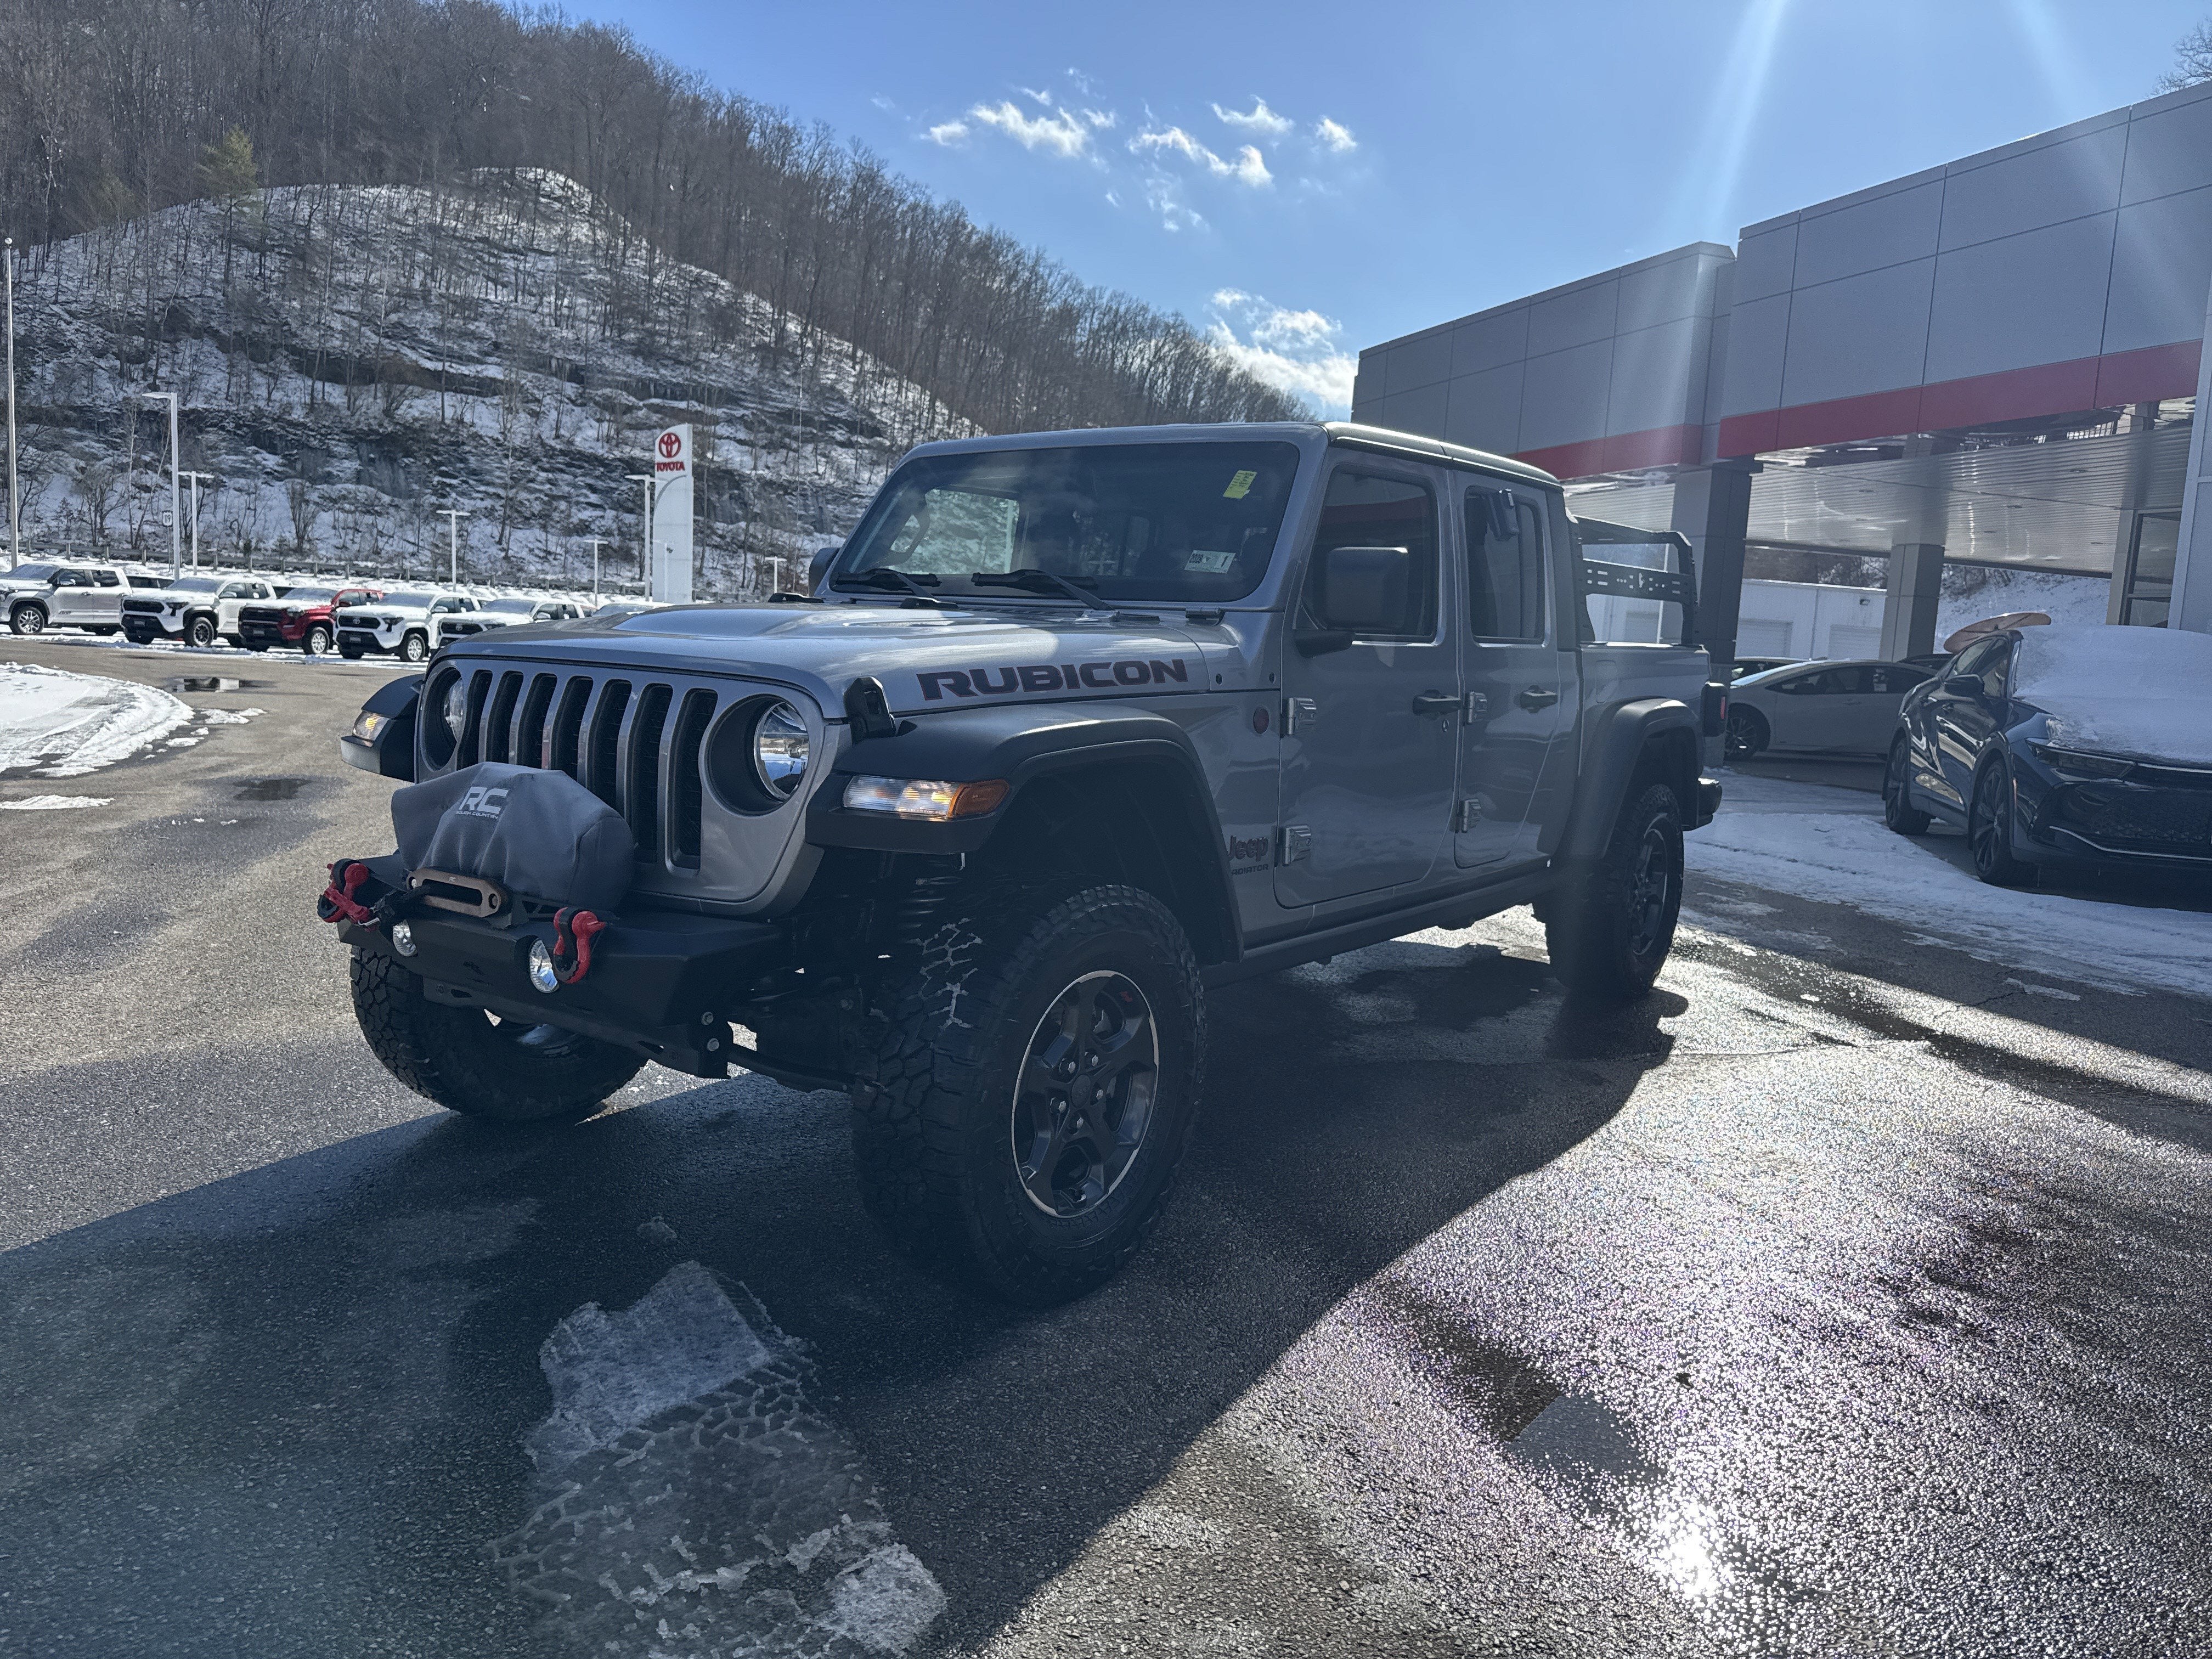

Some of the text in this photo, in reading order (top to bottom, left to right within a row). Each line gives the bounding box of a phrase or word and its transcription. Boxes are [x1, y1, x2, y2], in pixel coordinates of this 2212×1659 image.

[656, 462, 685, 472] TOYOTA
[916, 659, 1188, 701] RUBICON
[458, 787, 509, 815] RC
[472, 811, 499, 820] COUNTRY
[1228, 835, 1269, 862] Jeep
[1232, 864, 1269, 876] ADIATOR
